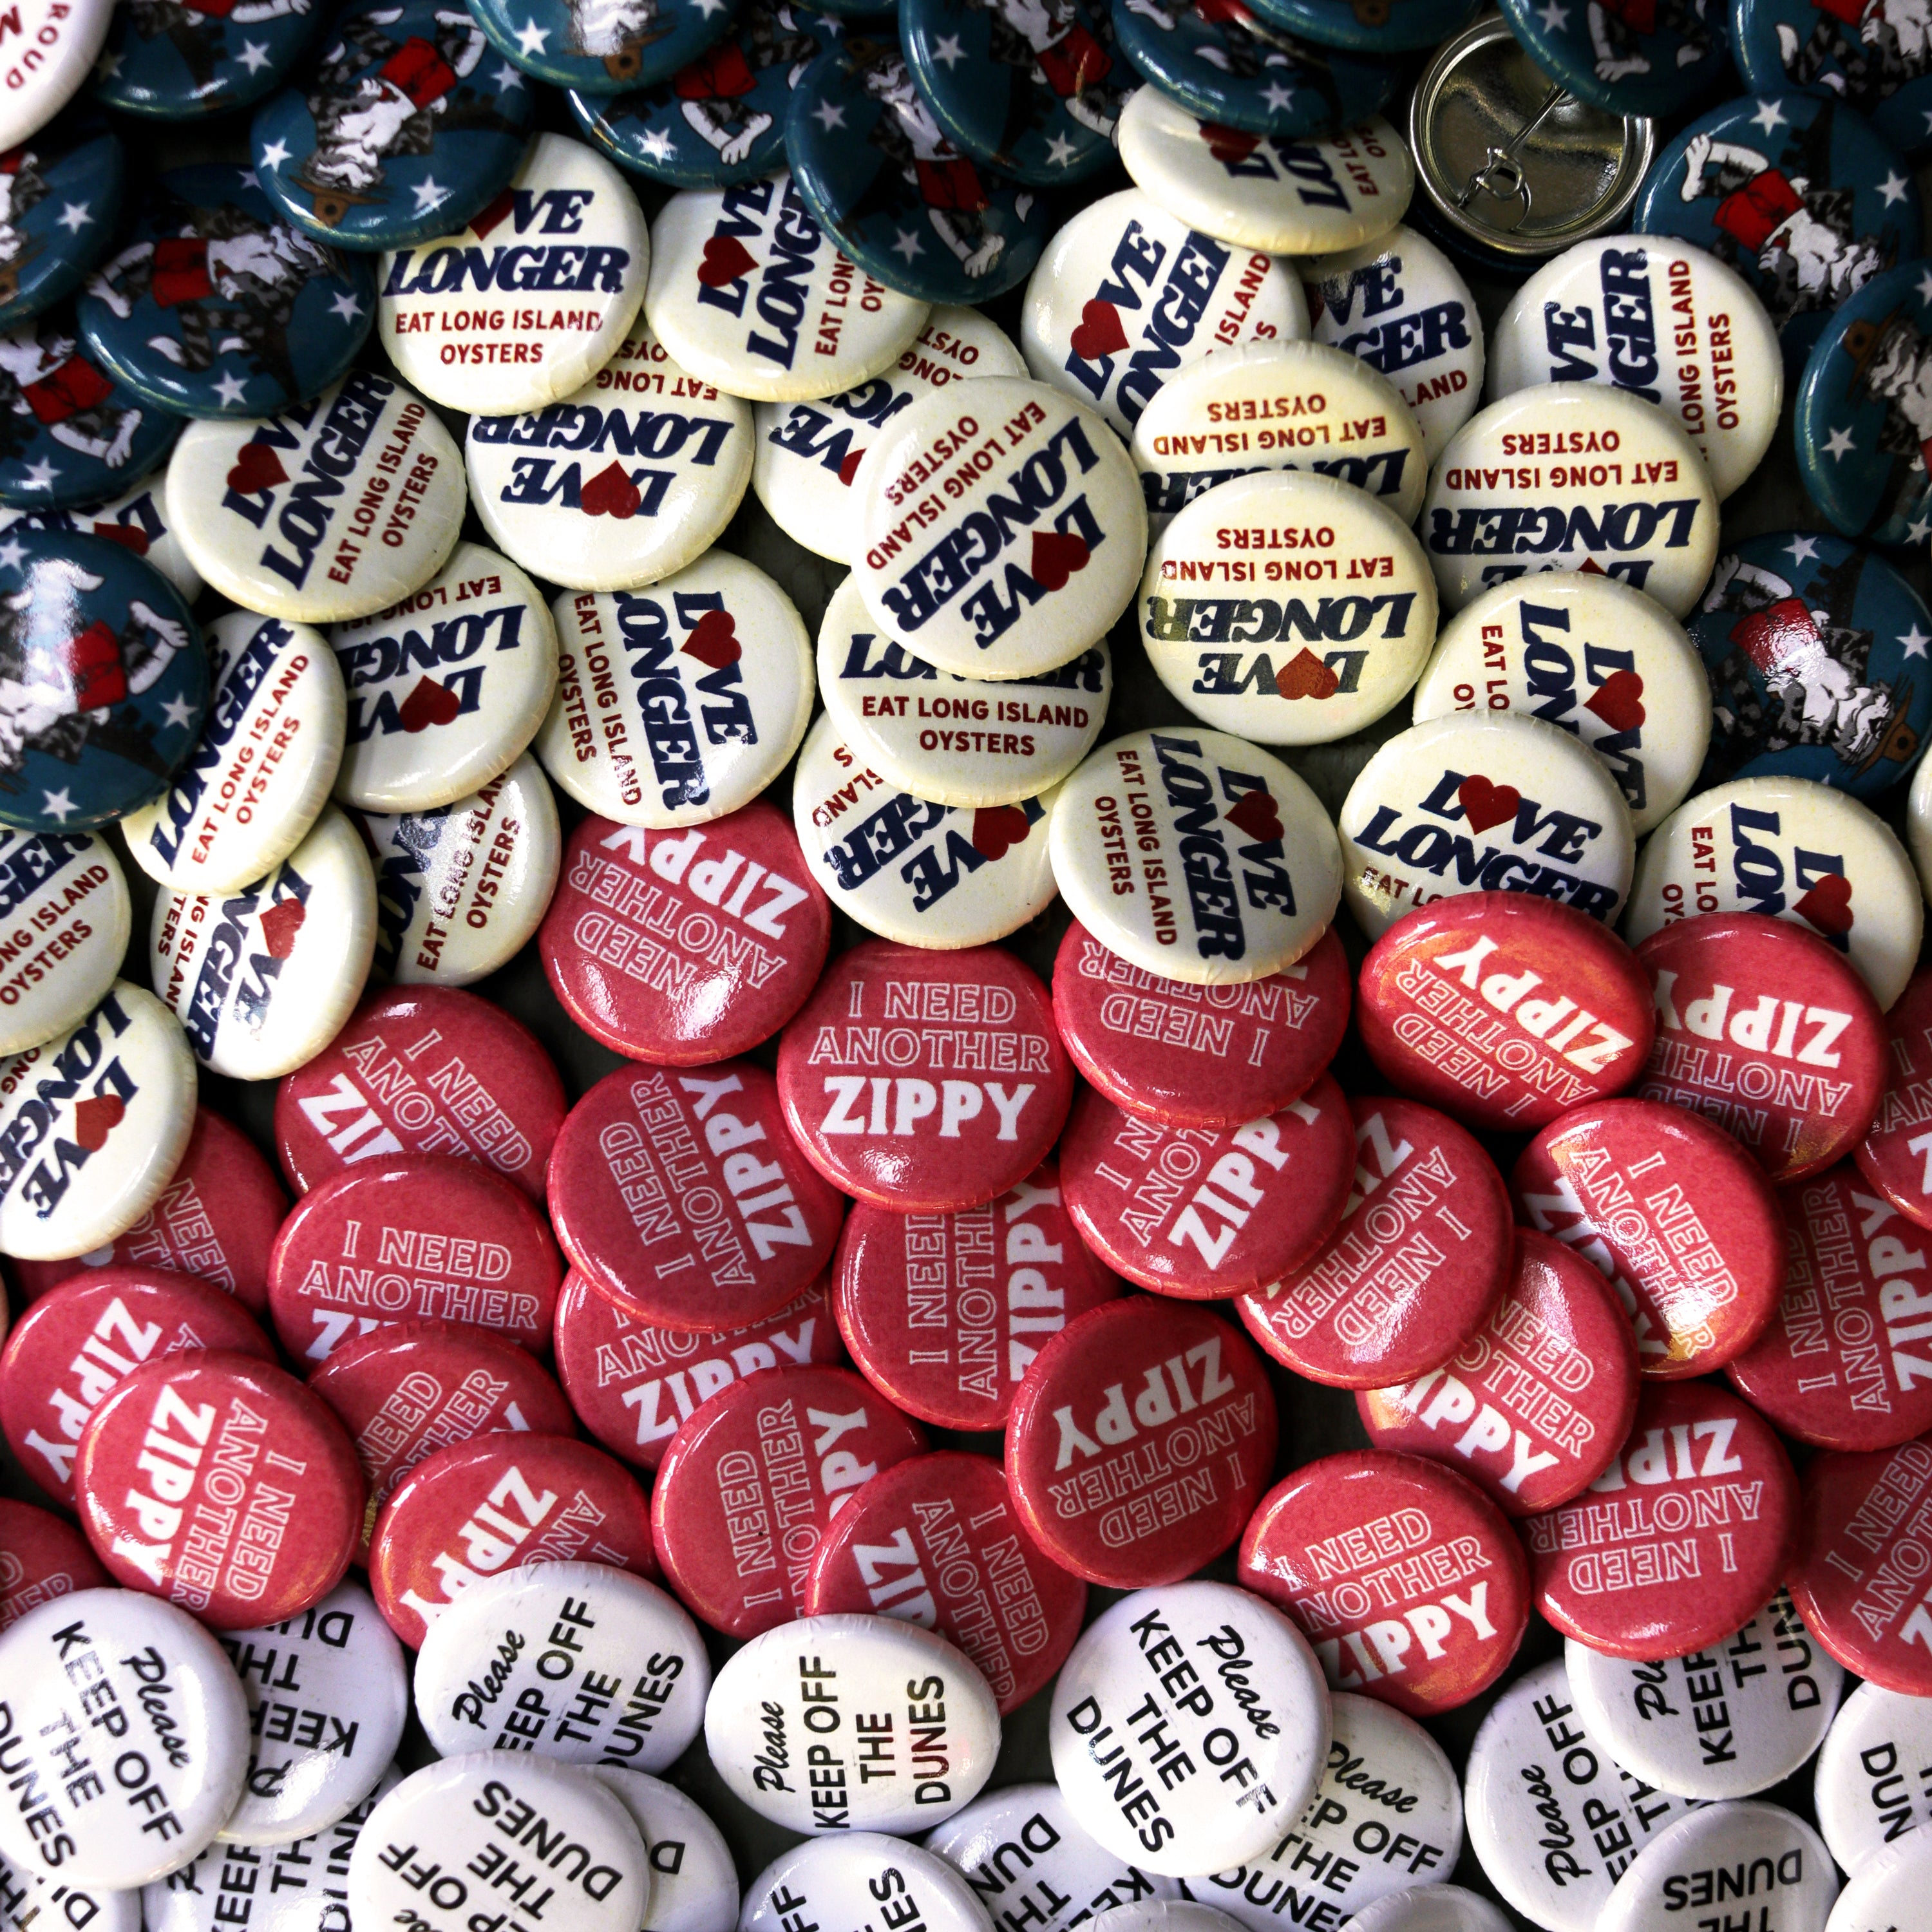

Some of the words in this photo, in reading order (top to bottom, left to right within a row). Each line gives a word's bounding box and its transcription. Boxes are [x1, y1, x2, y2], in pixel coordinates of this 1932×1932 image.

[382, 245, 630, 296] LONGER
[1215, 252, 1271, 345] ISLAND
[1669, 260, 1698, 356] ISLAND
[395, 312, 435, 334] EAT
[441, 310, 504, 332] LONG
[513, 310, 603, 332] ISLAND
[440, 343, 544, 365] OYSTERS
[815, 312, 843, 357] EAT
[596, 371, 665, 393] LONG
[1207, 393, 1327, 422] OYSTERS
[1678, 364, 1705, 436] LONG
[1708, 313, 1739, 430] OYSTERS
[885, 416, 979, 506] OYSTERS
[1003, 401, 1047, 446] EAT
[1153, 436, 1249, 456] ISLAND
[1258, 424, 1330, 449] LONG
[1339, 416, 1386, 443] EAT
[1502, 430, 1620, 455] OYSTERS
[260, 370, 395, 591] LONGER
[327, 539, 362, 585] EAT
[354, 475, 391, 538] LONG
[377, 402, 426, 484] ISLAND
[381, 453, 439, 548] OYSTERS
[943, 439, 1007, 500] LONG
[1446, 468, 1540, 490] ISLAND
[1549, 464, 1622, 488] LONG
[1631, 460, 1678, 483] EAT
[866, 498, 947, 570] ISLAND
[881, 416, 1100, 632] LONGER
[1217, 527, 1335, 549] OYSTERS
[1429, 498, 1701, 555] LONGER
[455, 576, 501, 601] EAT
[1162, 560, 1255, 582] ISLAND
[1264, 560, 1337, 582] LONG
[1347, 556, 1394, 579] EAT
[574, 592, 602, 636] EAT
[1146, 591, 1417, 643] LONGER
[1481, 625, 1506, 671] EAT
[558, 653, 598, 763] OYSTERS
[585, 641, 618, 708] LONG
[862, 696, 909, 717] EAT
[918, 697, 989, 721] LONG
[998, 701, 1089, 728] ISLAND
[192, 817, 219, 864] EAT
[214, 747, 254, 814] LONG
[249, 654, 309, 741] ISLAND
[236, 716, 300, 825] OYSTERS
[601, 713, 642, 806] ISLAND
[919, 729, 1036, 756] OYSTERS
[1116, 750, 1146, 786] EAT
[1095, 795, 1135, 896] OYSTERS
[1128, 792, 1160, 853] LONG
[1150, 733, 1245, 961] LONGER
[1691, 826, 1716, 873] EAT
[30, 865, 109, 932] ISLAND
[466, 817, 522, 929] OYSTERS
[1142, 858, 1177, 946] ISLAND
[416, 922, 447, 971] EAT
[569, 850, 787, 989] ANOTHER
[574, 911, 697, 1001] NEED
[0, 919, 93, 1006] OYSTERS
[849, 981, 864, 1018] I
[884, 981, 1016, 1024] NEED
[1101, 993, 1235, 1057] NEED
[1395, 958, 1598, 1106] ANOTHER
[1433, 935, 1634, 1075] ZIPPY
[1655, 969, 1853, 1068] ZIPPY
[808, 1026, 1051, 1073] ANOTHER
[1248, 1028, 1270, 1066] I
[1392, 1012, 1510, 1100] NEED
[404, 1028, 443, 1062] I
[427, 1056, 532, 1172] NEED
[819, 1075, 1036, 1141] ZIPPY
[1504, 1093, 1537, 1118] I
[599, 1121, 681, 1247] NEED
[630, 1071, 756, 1288] ANOTHER
[679, 1074, 812, 1261] ZIPPY
[1095, 1162, 1132, 1190] I
[1627, 1151, 1667, 1179] I
[342, 1220, 361, 1258] I
[377, 1226, 512, 1282] NEED
[1271, 1146, 1457, 1339] ANOTHER
[1435, 1205, 1472, 1241] I
[1645, 1182, 1739, 1307] NEED
[298, 1260, 540, 1330] ANOTHER
[655, 1253, 695, 1280] I
[1334, 1231, 1446, 1346] NEED
[1803, 1181, 1891, 1413] ANOTHER
[909, 1349, 949, 1365] I
[1491, 1293, 1595, 1392] NEED
[1052, 1336, 1236, 1472] ZIPPY
[1798, 1372, 1837, 1393] I
[265, 1450, 307, 1475] I
[358, 1371, 442, 1479] NEED
[1048, 1392, 1255, 1519] ANOTHER
[111, 1383, 217, 1587] ZIPPY
[170, 1396, 269, 1611] ANOTHER
[1099, 1467, 1218, 1548] NEED
[1227, 1452, 1246, 1490] I
[225, 1481, 296, 1602] NEED
[716, 1449, 777, 1577] NEED
[969, 1502, 1007, 1530] I
[1527, 1481, 1764, 1554] ANOTHER
[1824, 1550, 1864, 1582] I
[1844, 1441, 1932, 1554] NEED
[1274, 1555, 1302, 1591] I
[1305, 1508, 1432, 1581] NEED
[1568, 1539, 1701, 1595] NEED
[1719, 1533, 1738, 1573] I
[743, 1587, 782, 1609] I
[982, 1534, 1049, 1656] NEED
[536, 1596, 596, 1680] OFF
[1314, 1580, 1497, 1689] ZIPPY
[120, 1646, 193, 1769] Please
[451, 1629, 526, 1730] Please
[553, 1670, 622, 1743] THE
[799, 1656, 840, 1733] OFF
[1129, 1608, 1214, 1718] KEEP
[1202, 1727, 1278, 1814] OFF
[1197, 1624, 1281, 1739] Please
[39, 1707, 105, 1808] THE
[52, 1620, 129, 1738] KEEP
[115, 1749, 184, 1841] OFF
[752, 1701, 795, 1793] Please
[855, 1713, 896, 1784] THE
[906, 1675, 952, 1805] DUNES
[1126, 1692, 1197, 1791] THE
[1532, 1694, 1598, 1785] OFF
[808, 1744, 851, 1829] KEEP
[1066, 1695, 1175, 1853] DUNES
[473, 1780, 623, 1902] DUNES
[1352, 1821, 1444, 1875] OFF
[1521, 1764, 1592, 1886] Please
[378, 1843, 468, 1910] OFF
[466, 1842, 555, 1920] THE
[1271, 1833, 1361, 1893] THE
[1662, 1848, 1802, 1911] DUNES
